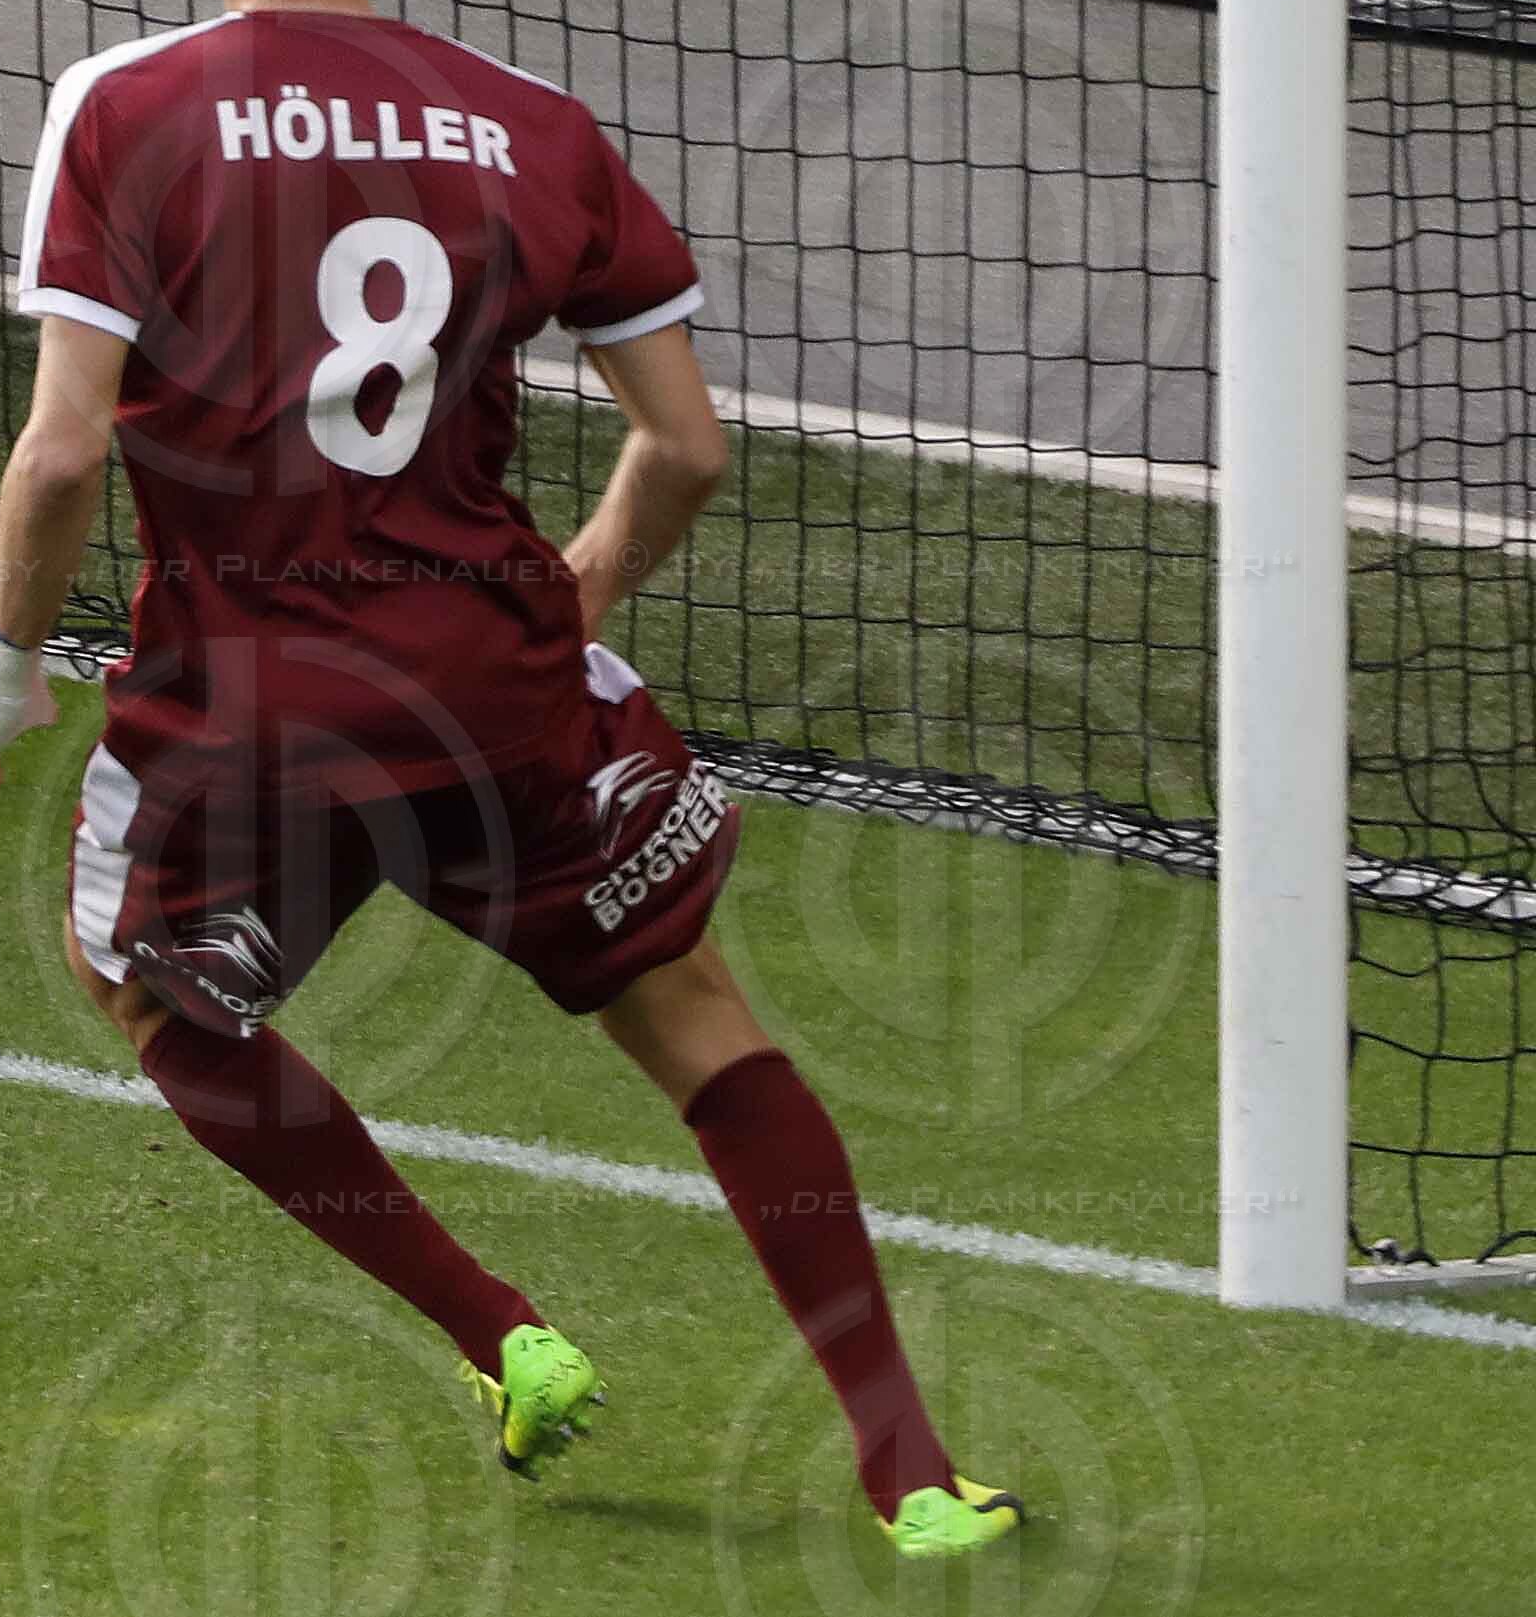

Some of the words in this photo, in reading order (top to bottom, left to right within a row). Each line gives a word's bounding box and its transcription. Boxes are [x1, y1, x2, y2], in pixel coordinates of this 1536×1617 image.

[215, 85, 518, 177] HÖLLER
[306, 216, 454, 478] 8
[593, 774, 729, 932] BOGNER
